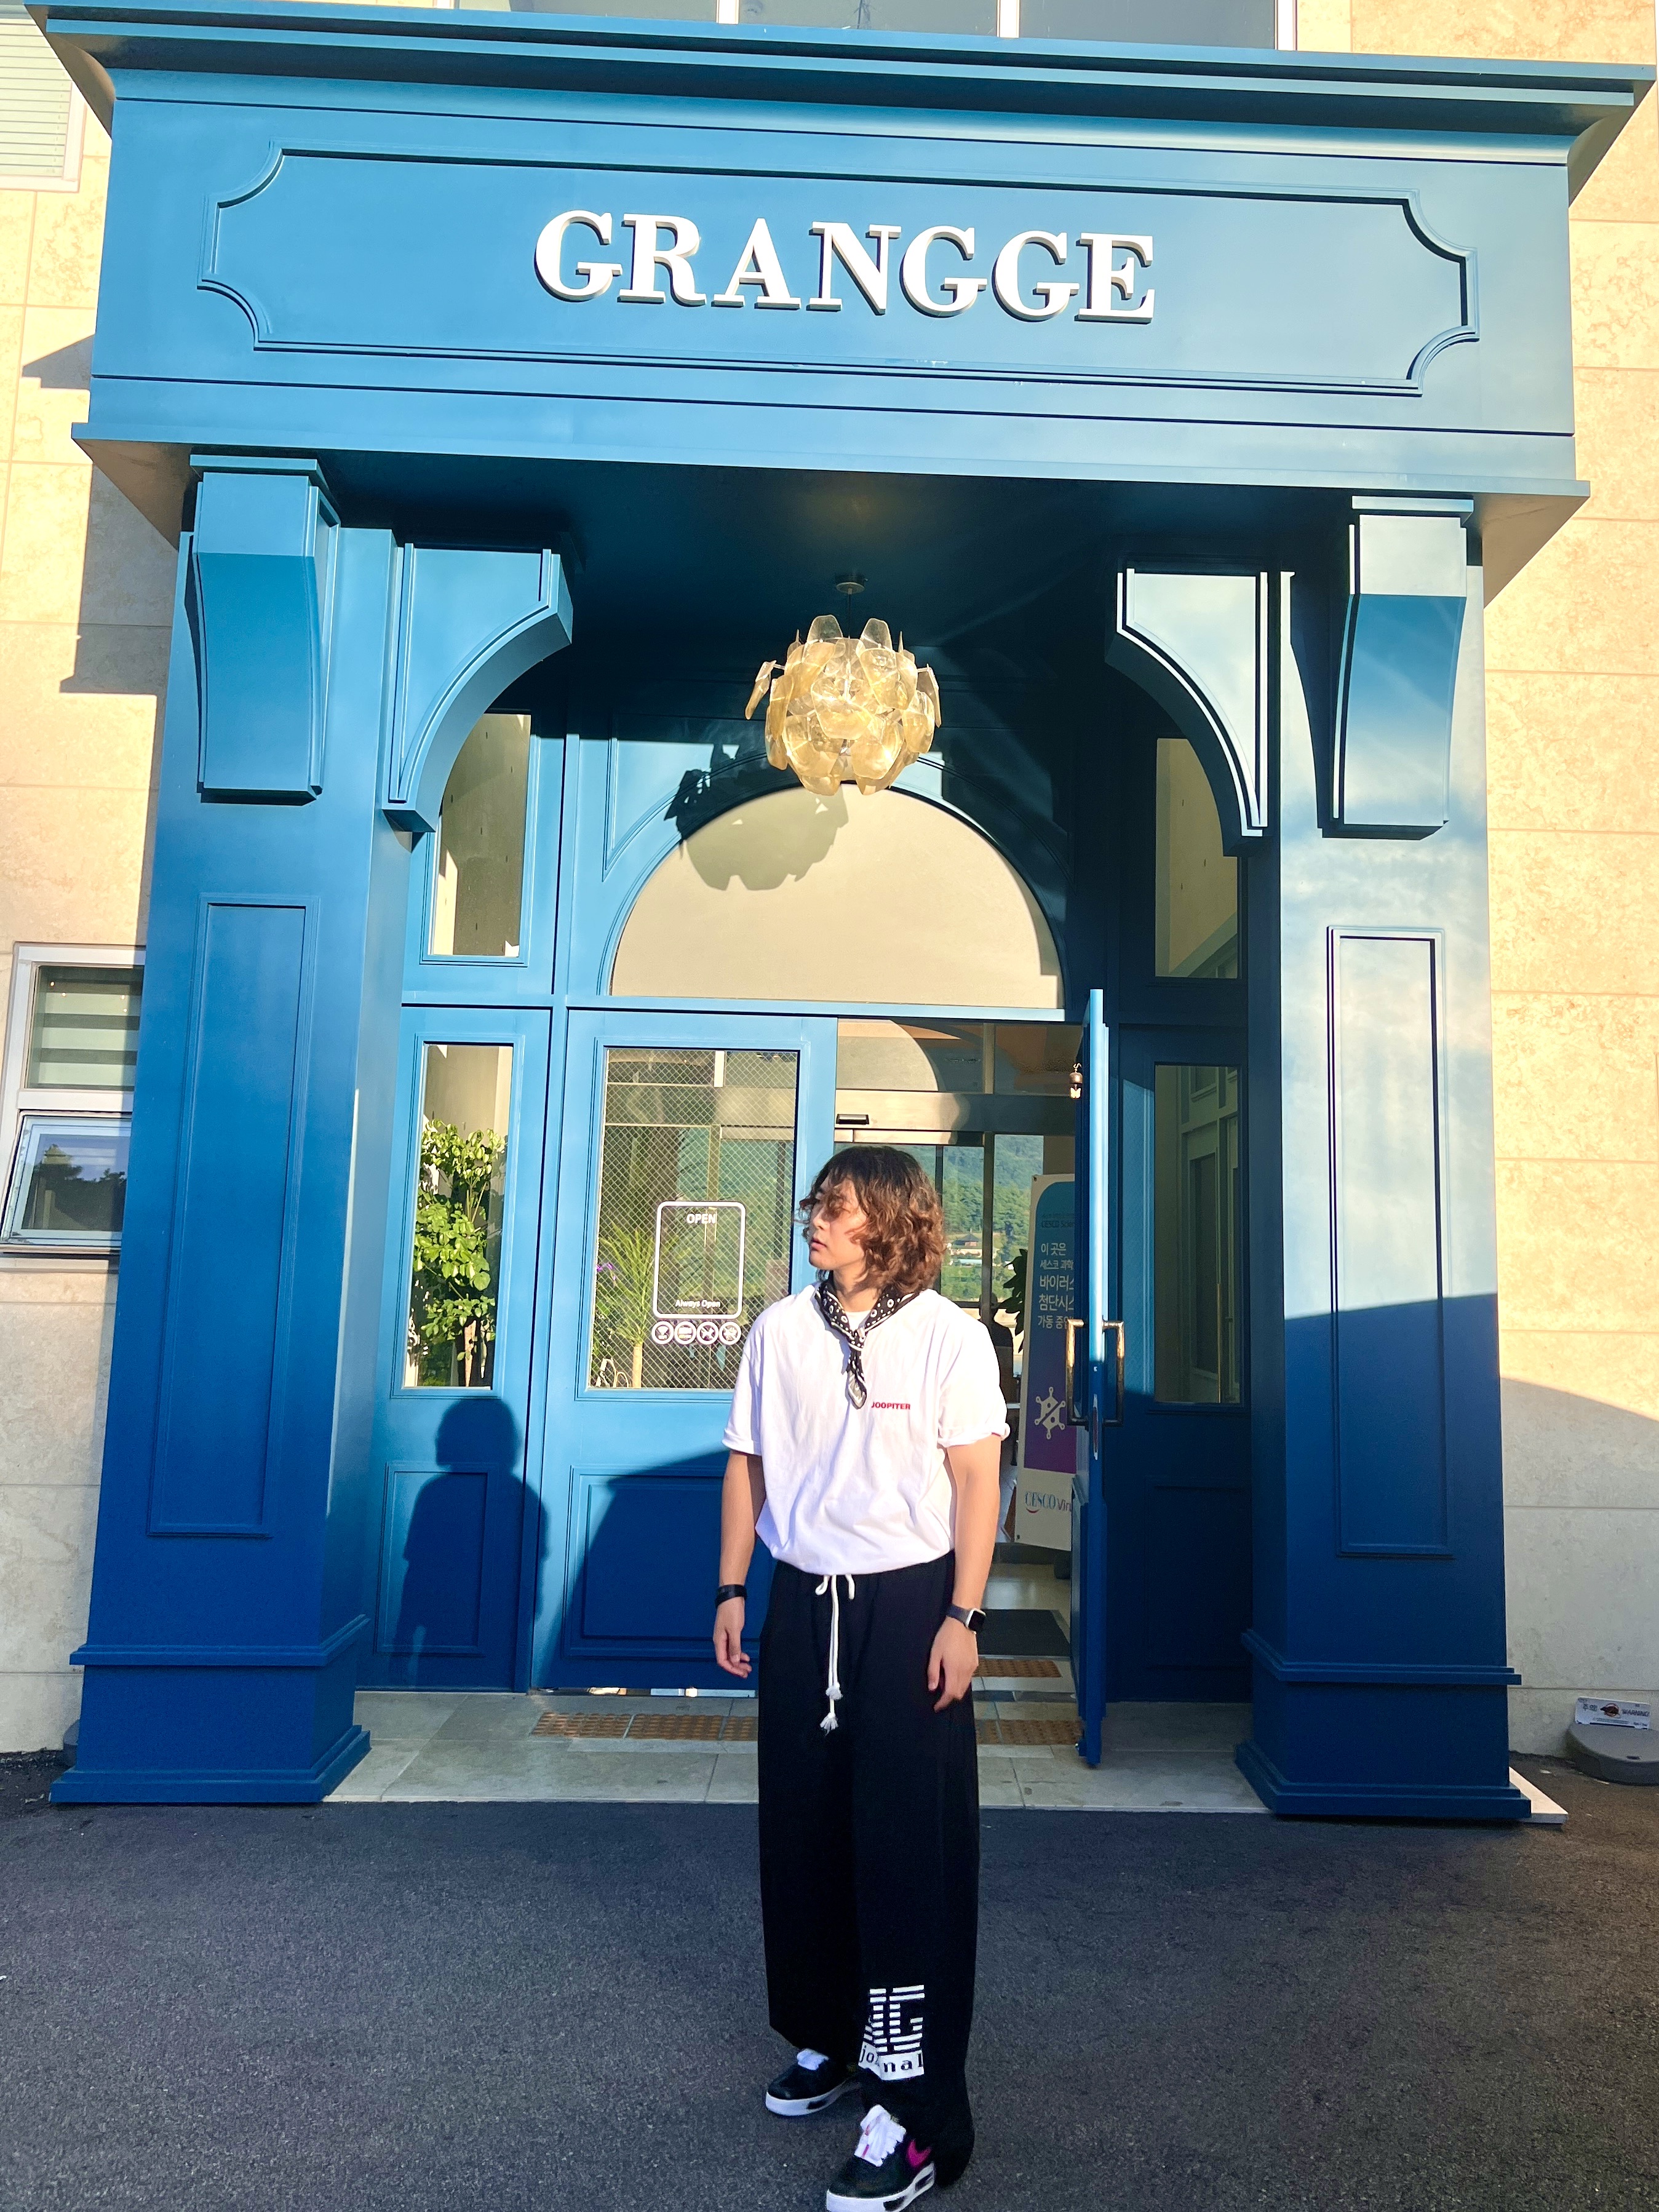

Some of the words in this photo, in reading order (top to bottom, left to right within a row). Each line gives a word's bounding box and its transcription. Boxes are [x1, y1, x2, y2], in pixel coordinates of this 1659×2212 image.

[534, 210, 1155, 325] GRANGGE
[686, 1213, 717, 1224] OPEN
[1041, 1243, 1049, 1255] 이
[1050, 1243, 1067, 1255] 곳은
[1040, 1259, 1059, 1270] 세스코
[675, 1299, 701, 1308] Always
[701, 1299, 721, 1308] Open
[1038, 1315, 1053, 1329] 가동
[871, 1401, 910, 1410] JOOPITER
[1024, 1491, 1056, 1510] CESCO
